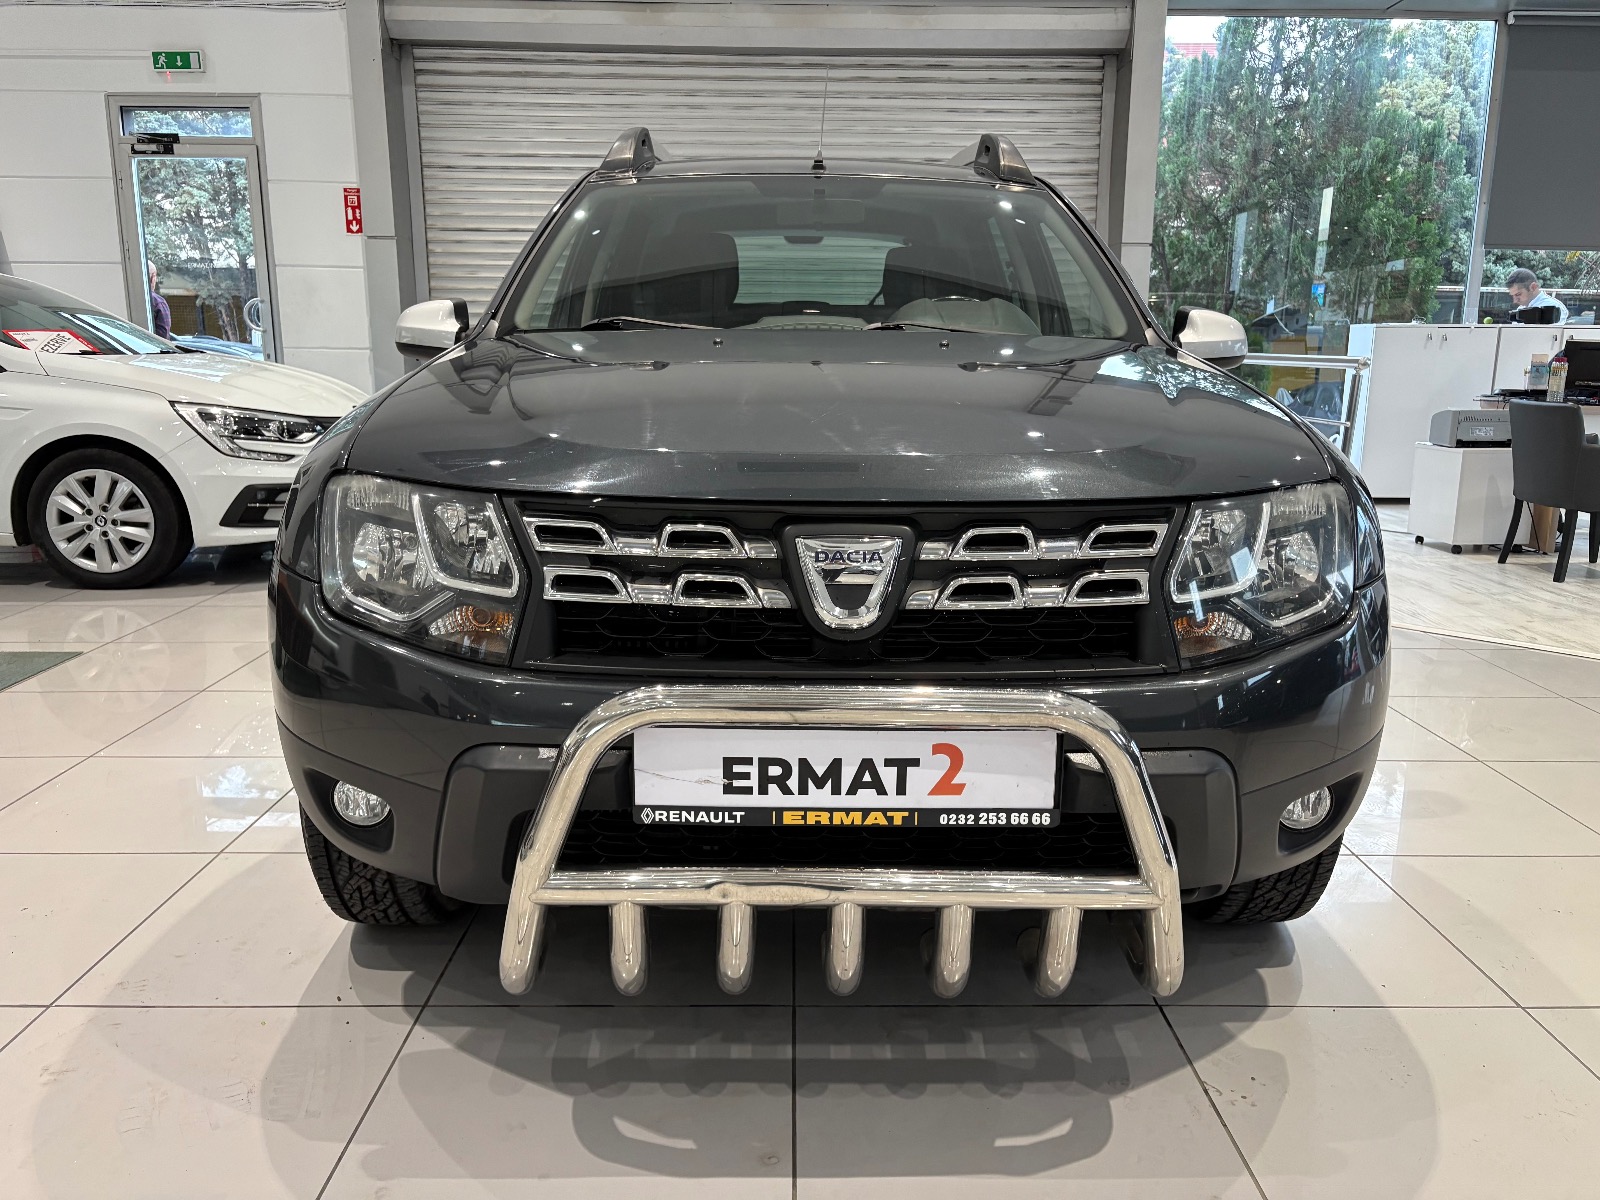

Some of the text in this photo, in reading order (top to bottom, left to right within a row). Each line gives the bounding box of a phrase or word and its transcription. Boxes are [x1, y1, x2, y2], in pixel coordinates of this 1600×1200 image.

[39, 333, 71, 353] EZERVE
[815, 550, 884, 563] DACIA
[722, 742, 967, 796] ERMAT 2
[654, 810, 1051, 826] RENAULT ERMAT 0232 253 66 66
